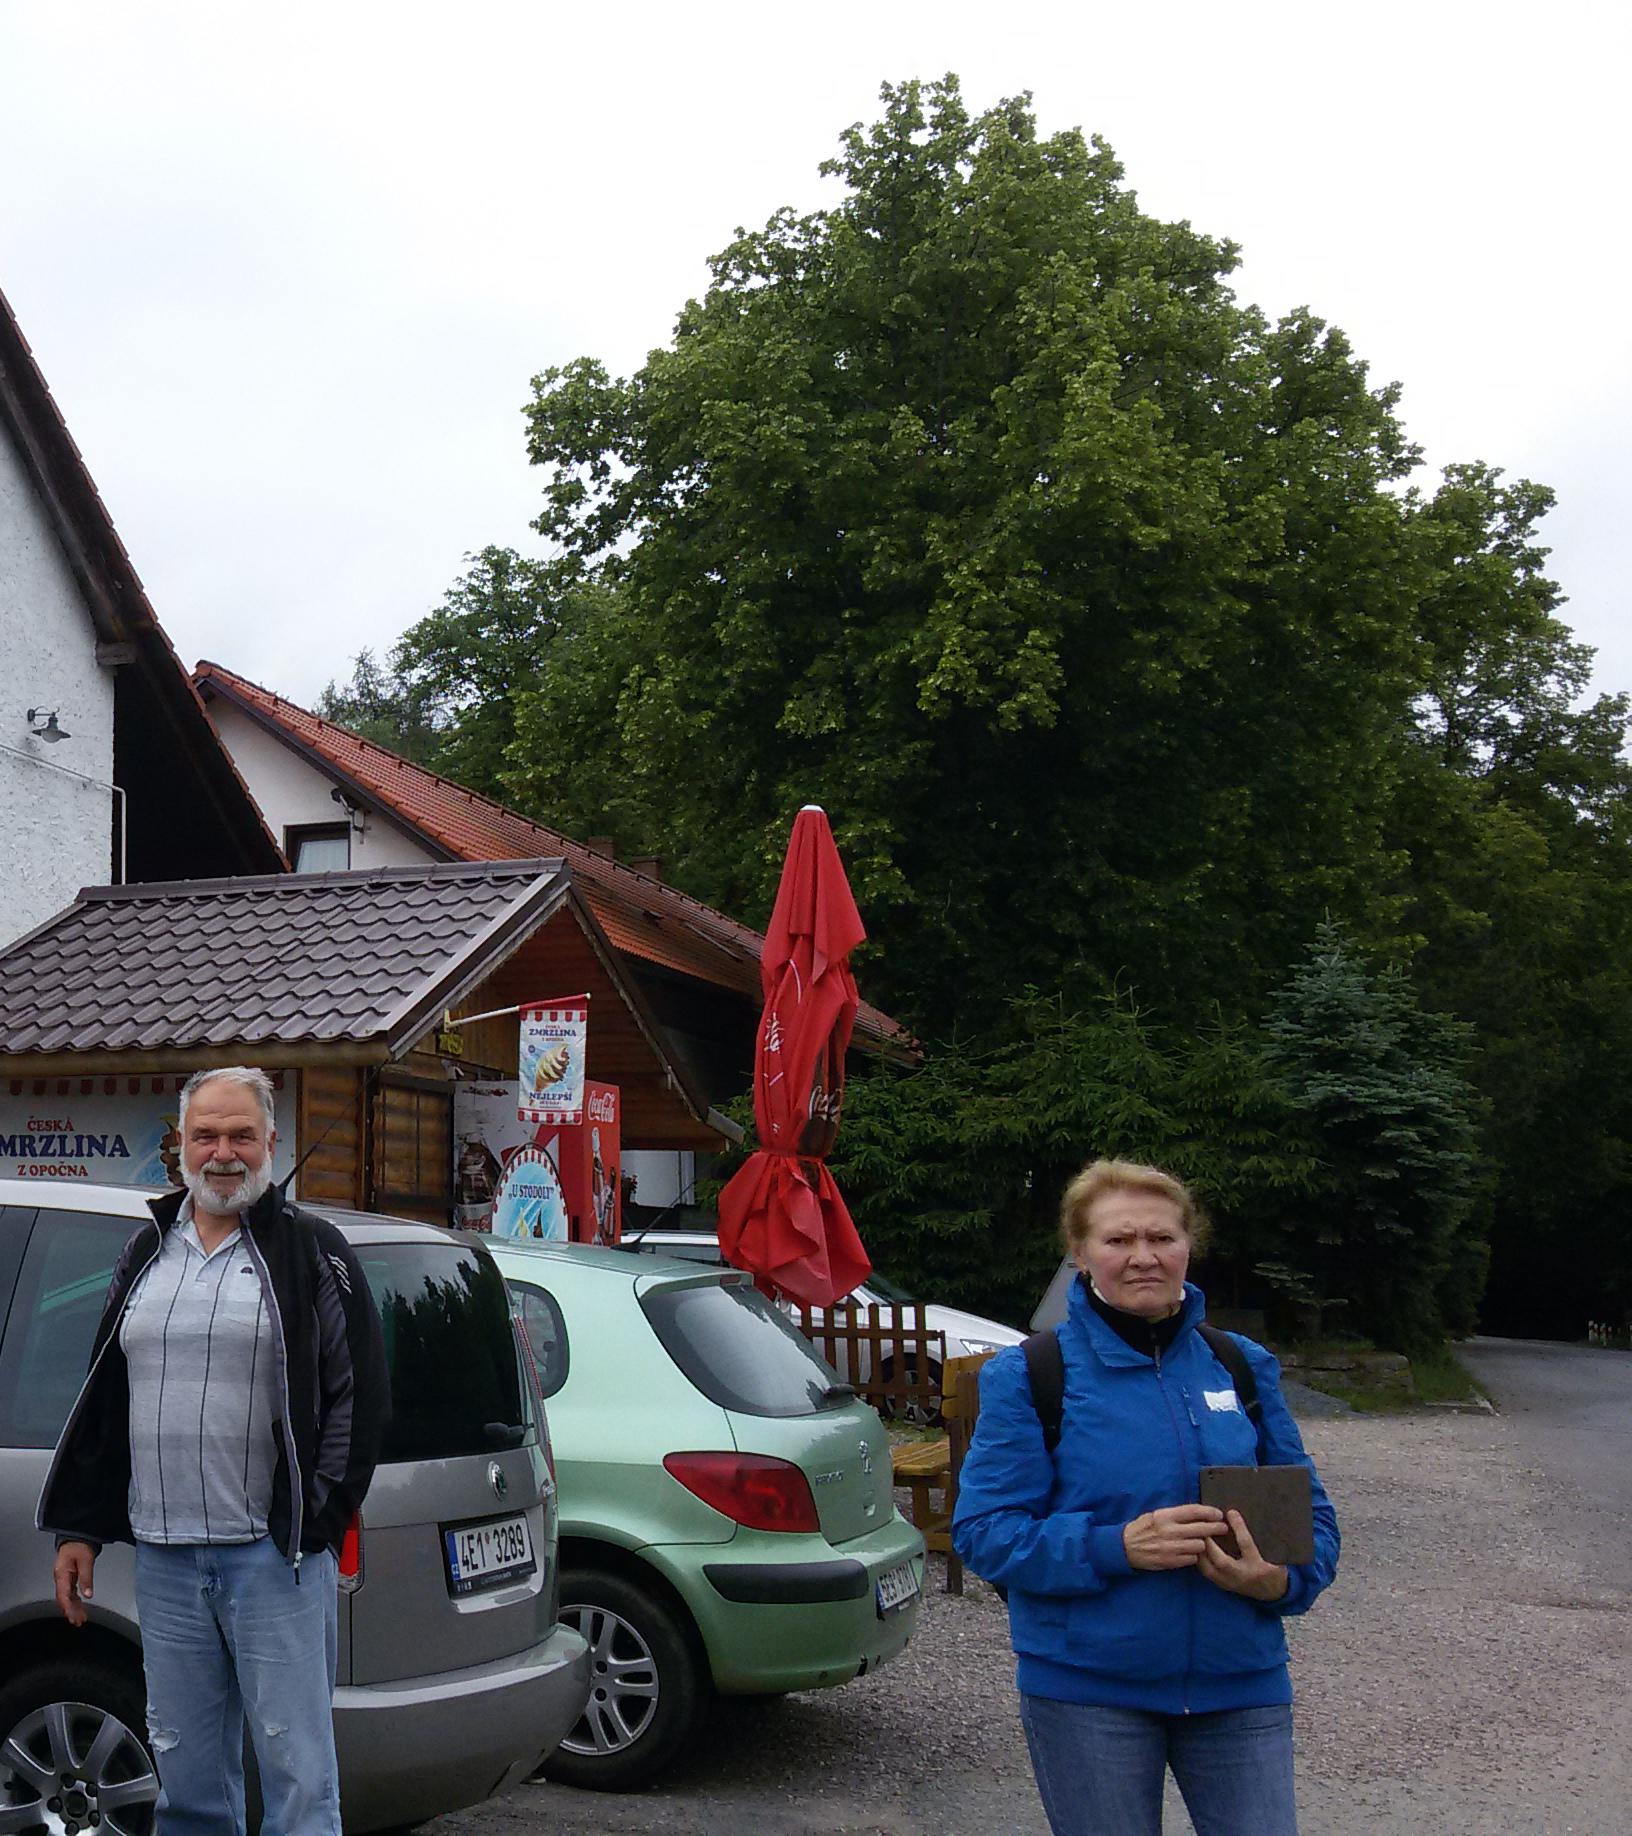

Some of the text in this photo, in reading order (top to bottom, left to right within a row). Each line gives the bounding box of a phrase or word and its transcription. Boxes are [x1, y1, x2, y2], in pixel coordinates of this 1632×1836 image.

[528, 1029, 576, 1037] ZMRZLINA
[27, 1115, 74, 1132] ČESKÁ
[18, 1161, 89, 1178] Z OPOČNA
[462, 1532, 486, 1572] 4E1
[493, 1523, 525, 1563] 3289
